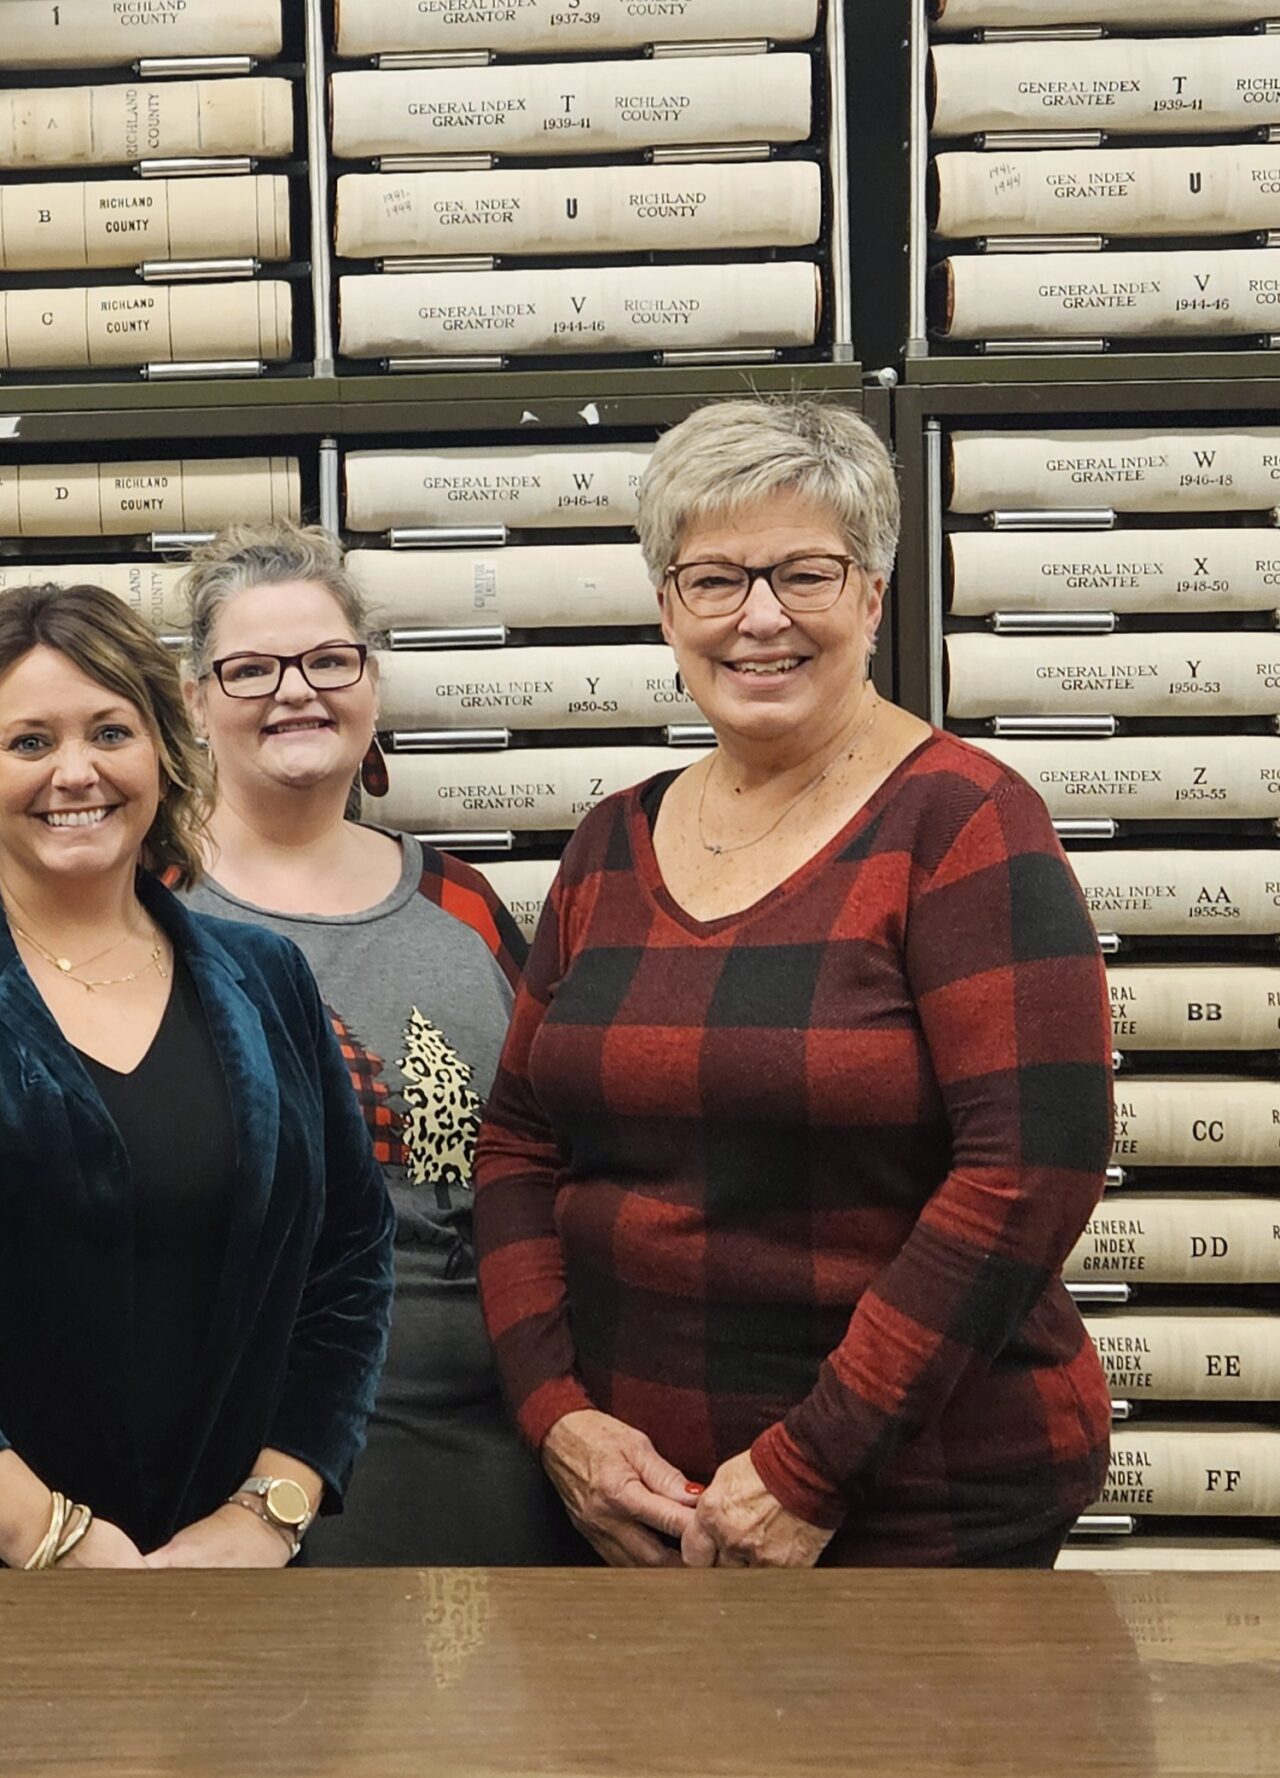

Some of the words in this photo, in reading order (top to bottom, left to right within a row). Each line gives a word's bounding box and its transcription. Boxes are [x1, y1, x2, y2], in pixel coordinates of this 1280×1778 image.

[52, 6, 59, 25] 1
[627, 2, 687, 16] COUNTY
[121, 13, 178, 25] COUNTY
[443, 9, 516, 24] GRANTOR
[550, 12, 600, 26] 1937-39
[1018, 81, 1088, 94] GENERAL
[1093, 80, 1140, 92] INDEX
[1172, 77, 1186, 94] T
[408, 102, 477, 115] GENERAL
[481, 98, 526, 112] INDEX
[561, 96, 575, 112] T
[615, 96, 690, 108] RICHLAND
[1042, 94, 1115, 106] GRANTEE
[1153, 99, 1203, 112] 1939-41
[148, 92, 159, 147] COUNTY
[432, 114, 505, 127] GRANTOR
[621, 109, 682, 122] COUNTY
[126, 89, 137, 157] RICHLAND
[543, 117, 591, 130] 1939-41
[1046, 174, 1079, 185] GEN.
[1089, 171, 1135, 184] INDEX
[1190, 172, 1201, 194] U
[1054, 184, 1128, 198] GRANTEE
[99, 196, 153, 209] RICHLAND
[434, 200, 467, 212] GEN.
[475, 198, 520, 210] INDEX
[630, 192, 706, 206] RICHLAND
[567, 198, 578, 219] U
[637, 205, 698, 218] COUNTY
[39, 210, 51, 223] B
[440, 210, 513, 224] GRANTOR
[105, 219, 149, 233] COUNTY
[1039, 285, 1109, 297] GENERAL
[1113, 281, 1160, 295] INDEX
[1194, 275, 1210, 291] V
[101, 298, 154, 311] RICHLAND
[571, 297, 586, 314] V
[624, 300, 699, 312] RICHLAND
[1063, 296, 1136, 309] GRANTEE
[1175, 298, 1229, 310] 1944-46
[419, 306, 487, 319] GENERAL
[491, 303, 536, 316] INDEX
[631, 312, 691, 324] COUNTY
[42, 312, 53, 326] C
[443, 316, 515, 330] GRANTOR
[106, 320, 149, 333] COUNTY
[553, 320, 605, 334] 1944-46
[1046, 459, 1116, 471] GENERAL
[1122, 455, 1169, 468] INDEX
[1193, 451, 1216, 467] W
[423, 477, 491, 489] GENERAL
[496, 476, 541, 488] INDEX
[572, 473, 594, 491] W
[1071, 470, 1144, 482] GRANTEE
[1179, 474, 1232, 486] 1946-48
[115, 477, 168, 490] RICHLAND
[55, 487, 69, 500] D
[448, 489, 519, 500] GRANTOR
[121, 498, 164, 511] COUNTY
[558, 495, 609, 507] 1946-48
[1041, 564, 1112, 575] GENERAL
[1117, 563, 1164, 574] INDEX
[1194, 558, 1209, 575] X
[1066, 576, 1139, 588] GRANTEE
[1176, 580, 1228, 592] 1948-50
[1036, 667, 1106, 678] GENERAL
[1111, 665, 1158, 676] INDEX
[1186, 661, 1201, 677] Y
[436, 684, 503, 697] GENERAL
[509, 681, 554, 693] INDEX
[586, 678, 600, 694] Y
[1061, 678, 1134, 690] GRANTEE
[1169, 682, 1220, 694] 1950-53
[461, 695, 532, 707] GRANTOR
[568, 701, 618, 712] 1950-53
[1039, 771, 1110, 782] GENERAL
[1115, 770, 1162, 781] INDEX
[1193, 768, 1207, 785] Z
[438, 786, 505, 798] GENERAL
[511, 784, 555, 796] INDEX
[589, 779, 603, 795] Z
[1065, 783, 1138, 795] GRANTEE
[1175, 789, 1226, 800] 1953-55
[463, 797, 535, 809] GRANTOR
[1129, 885, 1176, 898] INDEX
[1197, 886, 1231, 903] AA
[1188, 906, 1240, 918] 1955-58
[1188, 1003, 1222, 1021] BB
[1192, 1120, 1224, 1142] CC
[1094, 1239, 1135, 1253] INDEX
[1190, 1237, 1228, 1258] DD
[1083, 1257, 1145, 1271] GRANTEE
[1206, 1355, 1240, 1377] EE
[1206, 1470, 1241, 1491] FF
